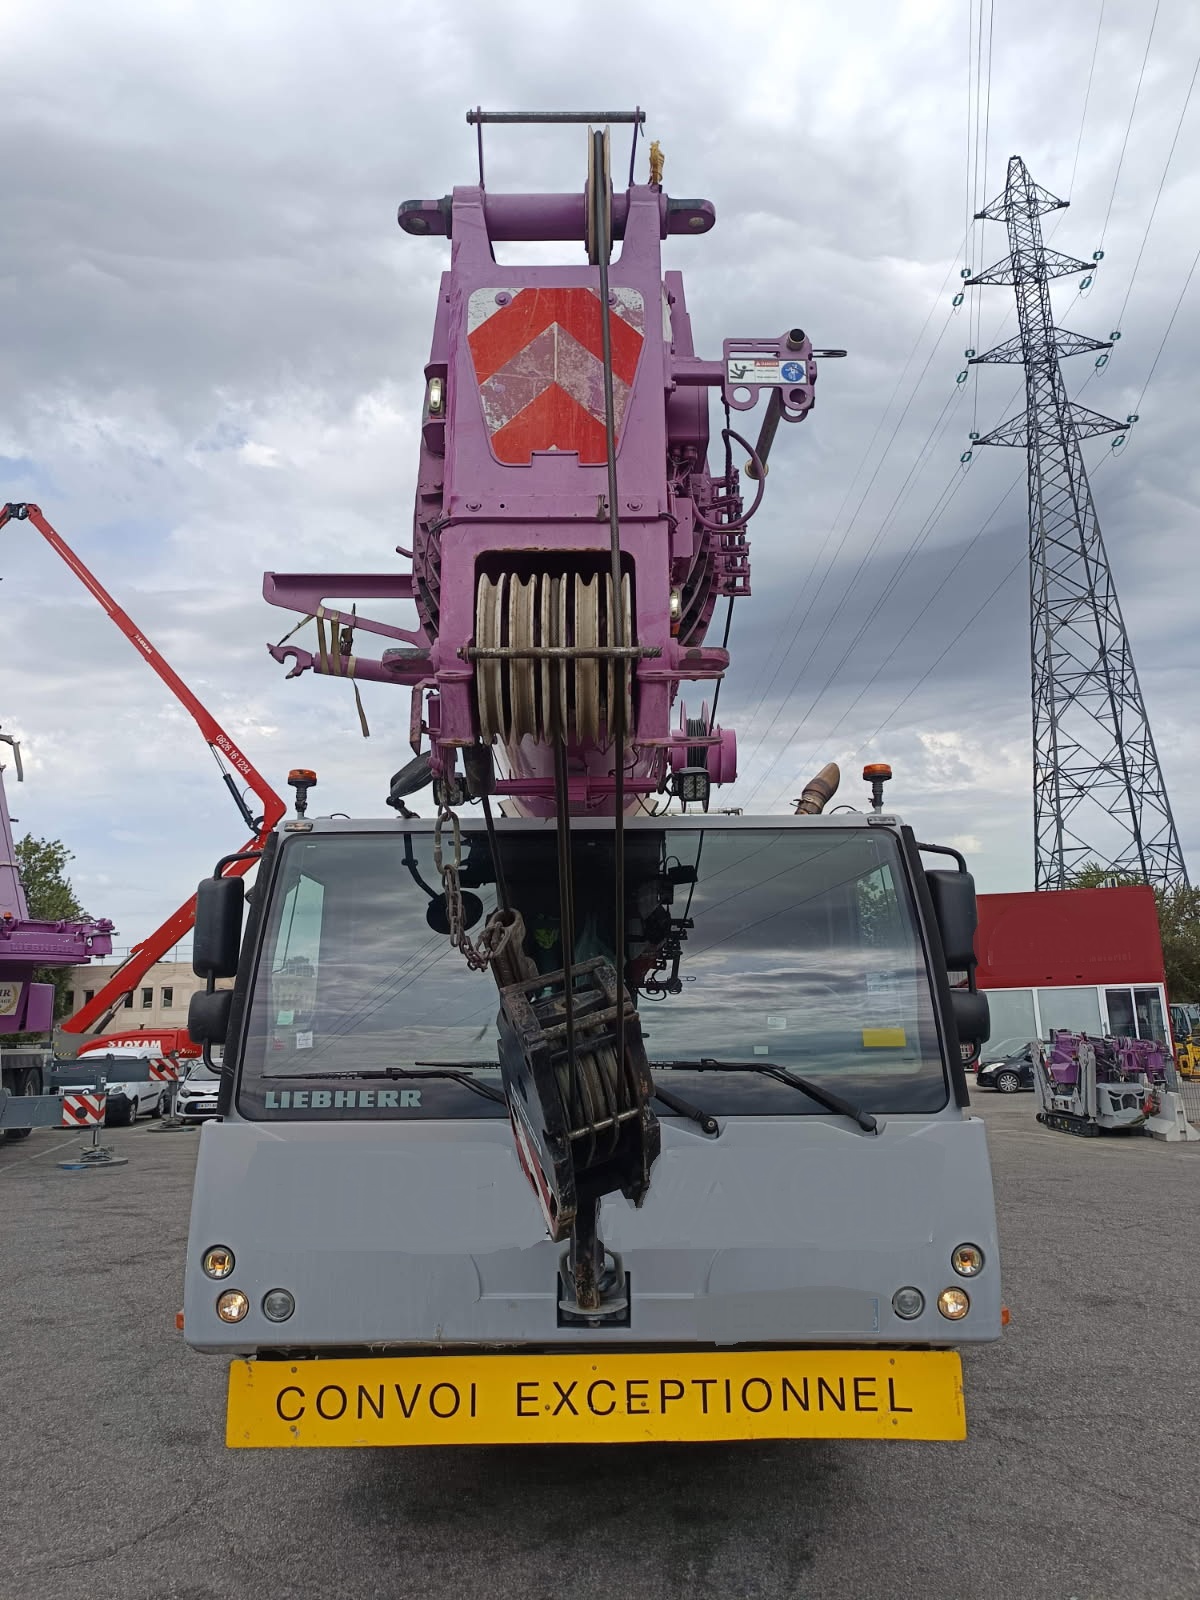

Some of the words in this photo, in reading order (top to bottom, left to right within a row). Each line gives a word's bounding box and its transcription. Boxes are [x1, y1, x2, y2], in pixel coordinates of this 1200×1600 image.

[216, 734, 232, 751] 0826
[229, 750, 239, 759] 16
[236, 758, 251, 774] 1234
[117, 1040, 161, 1049] LOXAM
[264, 1090, 422, 1109] LIEBHERR
[276, 1382, 477, 1423] CONVOI
[515, 1375, 914, 1418] EXCEPTIONNEL
